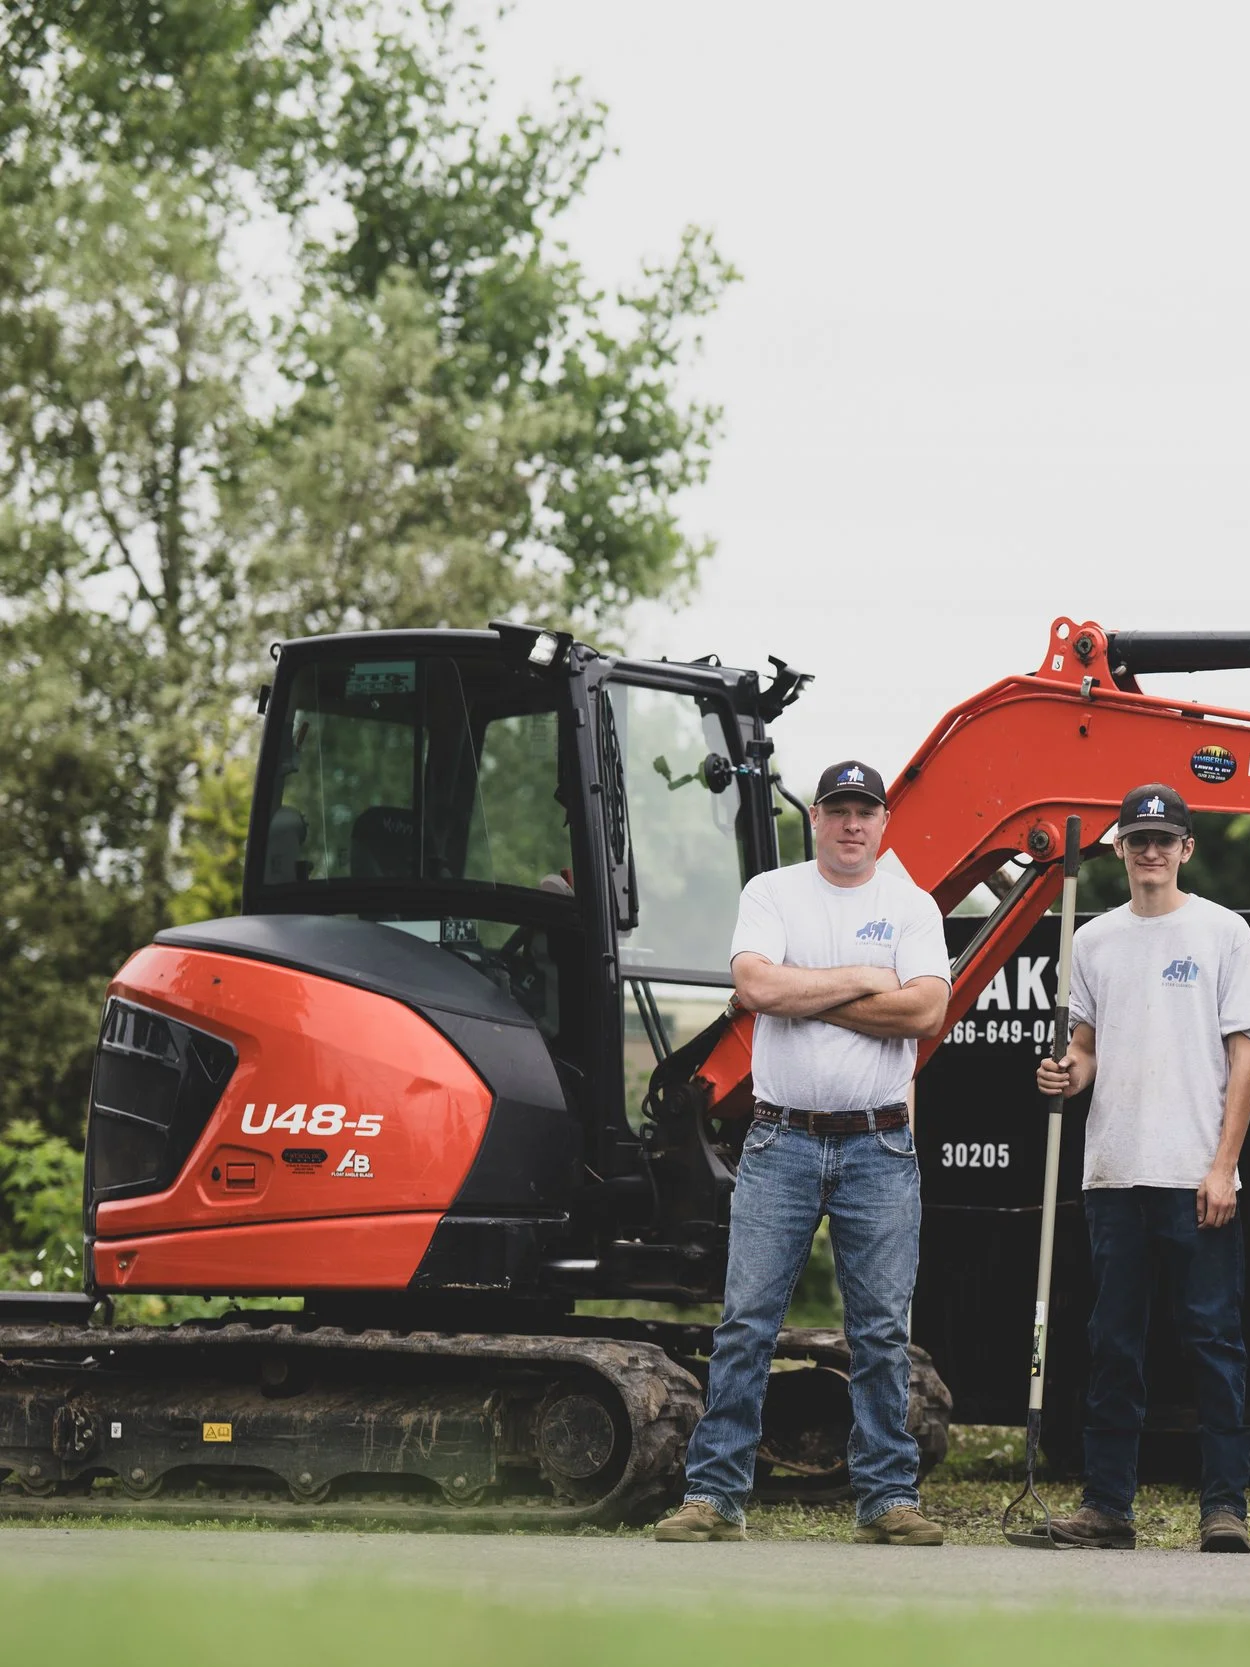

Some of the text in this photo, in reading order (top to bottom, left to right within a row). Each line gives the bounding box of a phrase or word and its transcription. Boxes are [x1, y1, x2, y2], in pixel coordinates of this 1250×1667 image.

[950, 956, 1060, 1010] AK
[241, 1103, 384, 1137] U48-5
[942, 1143, 1010, 1168] 30205
